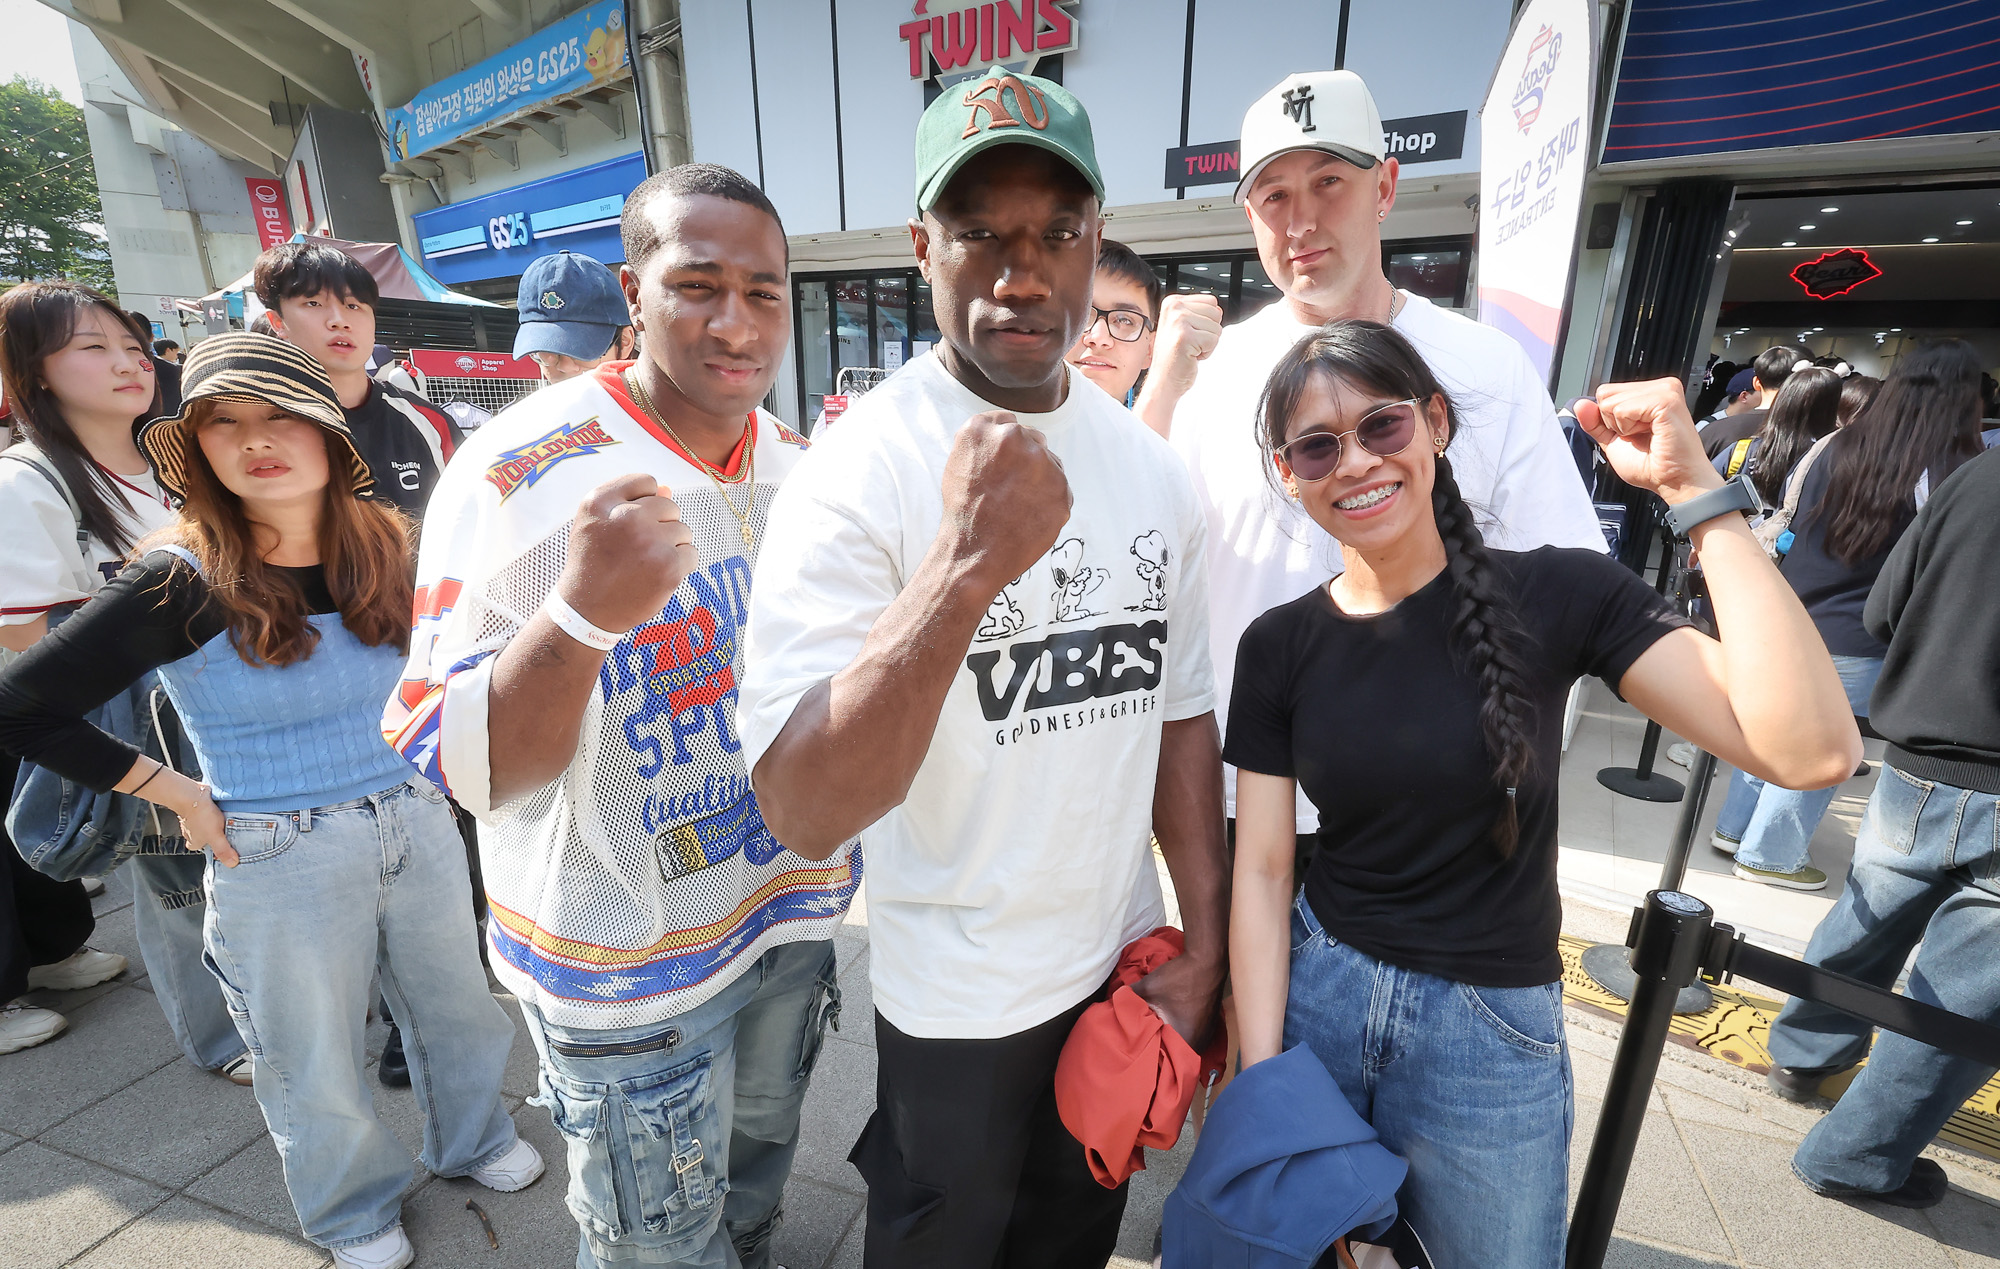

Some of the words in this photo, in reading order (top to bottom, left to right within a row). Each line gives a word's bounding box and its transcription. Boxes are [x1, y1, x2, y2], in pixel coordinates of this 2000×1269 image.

[899, 0, 1072, 77] TWINS
[415, 89, 462, 137] 잠실야구장
[463, 74, 497, 116] 직관의
[536, 36, 581, 85] GS25
[488, 211, 529, 251] GS25
[485, 420, 615, 498] WORLDWIDE
[967, 619, 1168, 722] VIBES
